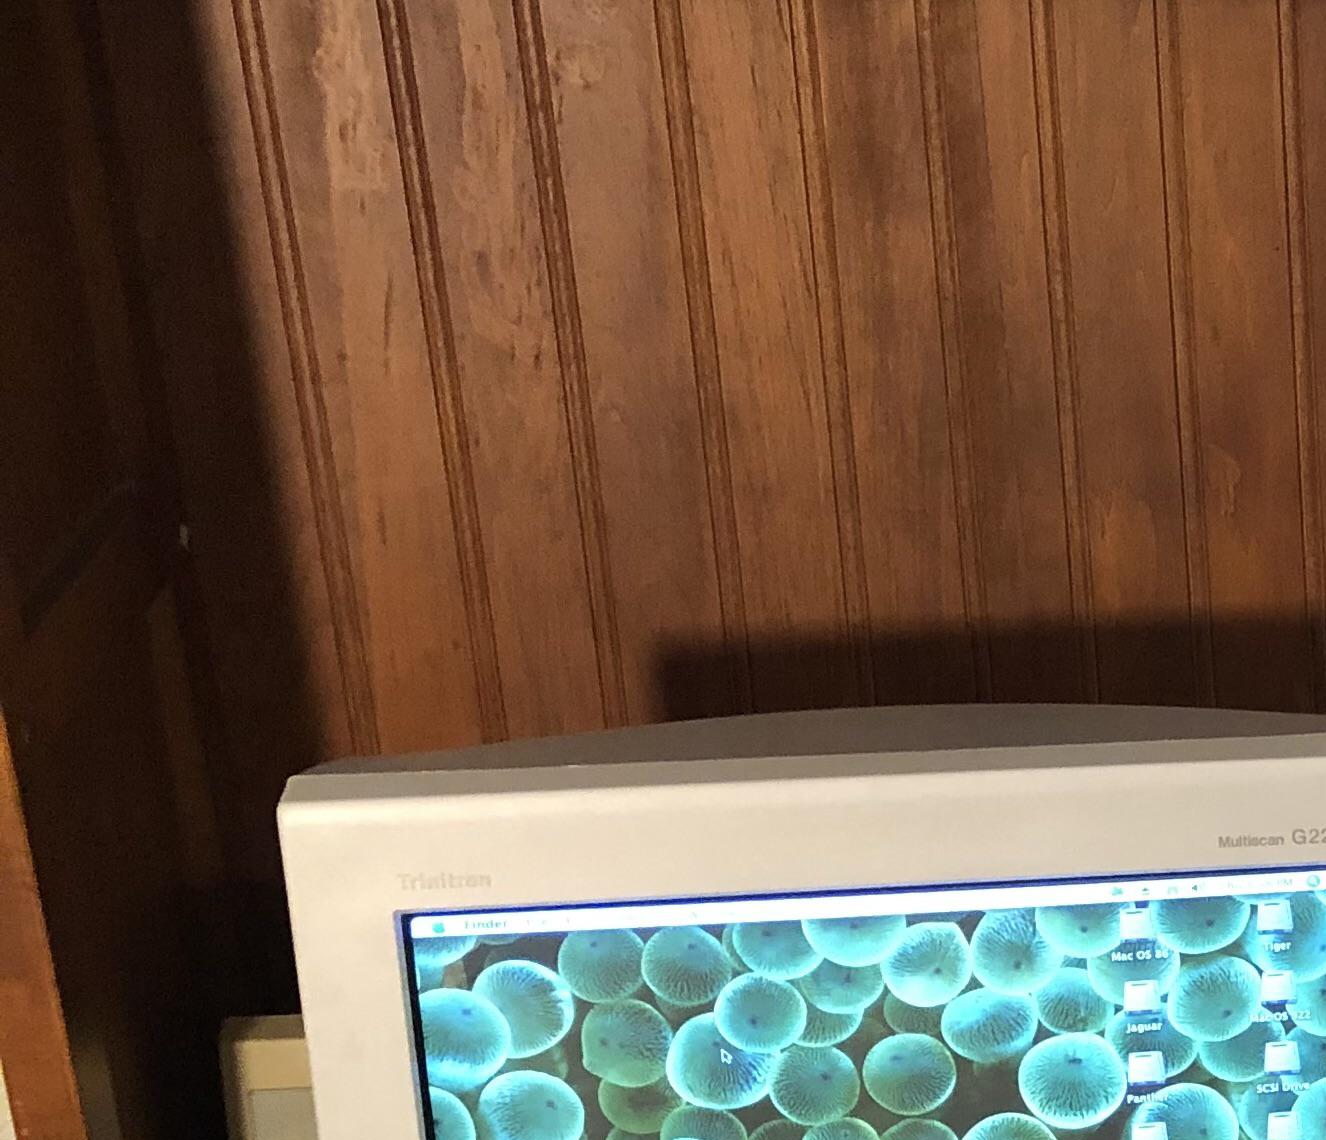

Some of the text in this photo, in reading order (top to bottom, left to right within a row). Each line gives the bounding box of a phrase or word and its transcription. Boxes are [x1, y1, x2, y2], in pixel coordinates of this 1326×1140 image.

[1217, 835, 1285, 848] Multiscan
[1263, 941, 1292, 953] Tiger
[1111, 951, 1134, 962] Mac
[1136, 950, 1152, 961] OS
[1126, 1022, 1163, 1034] Jaguar
[1126, 1092, 1169, 1104] Panther
